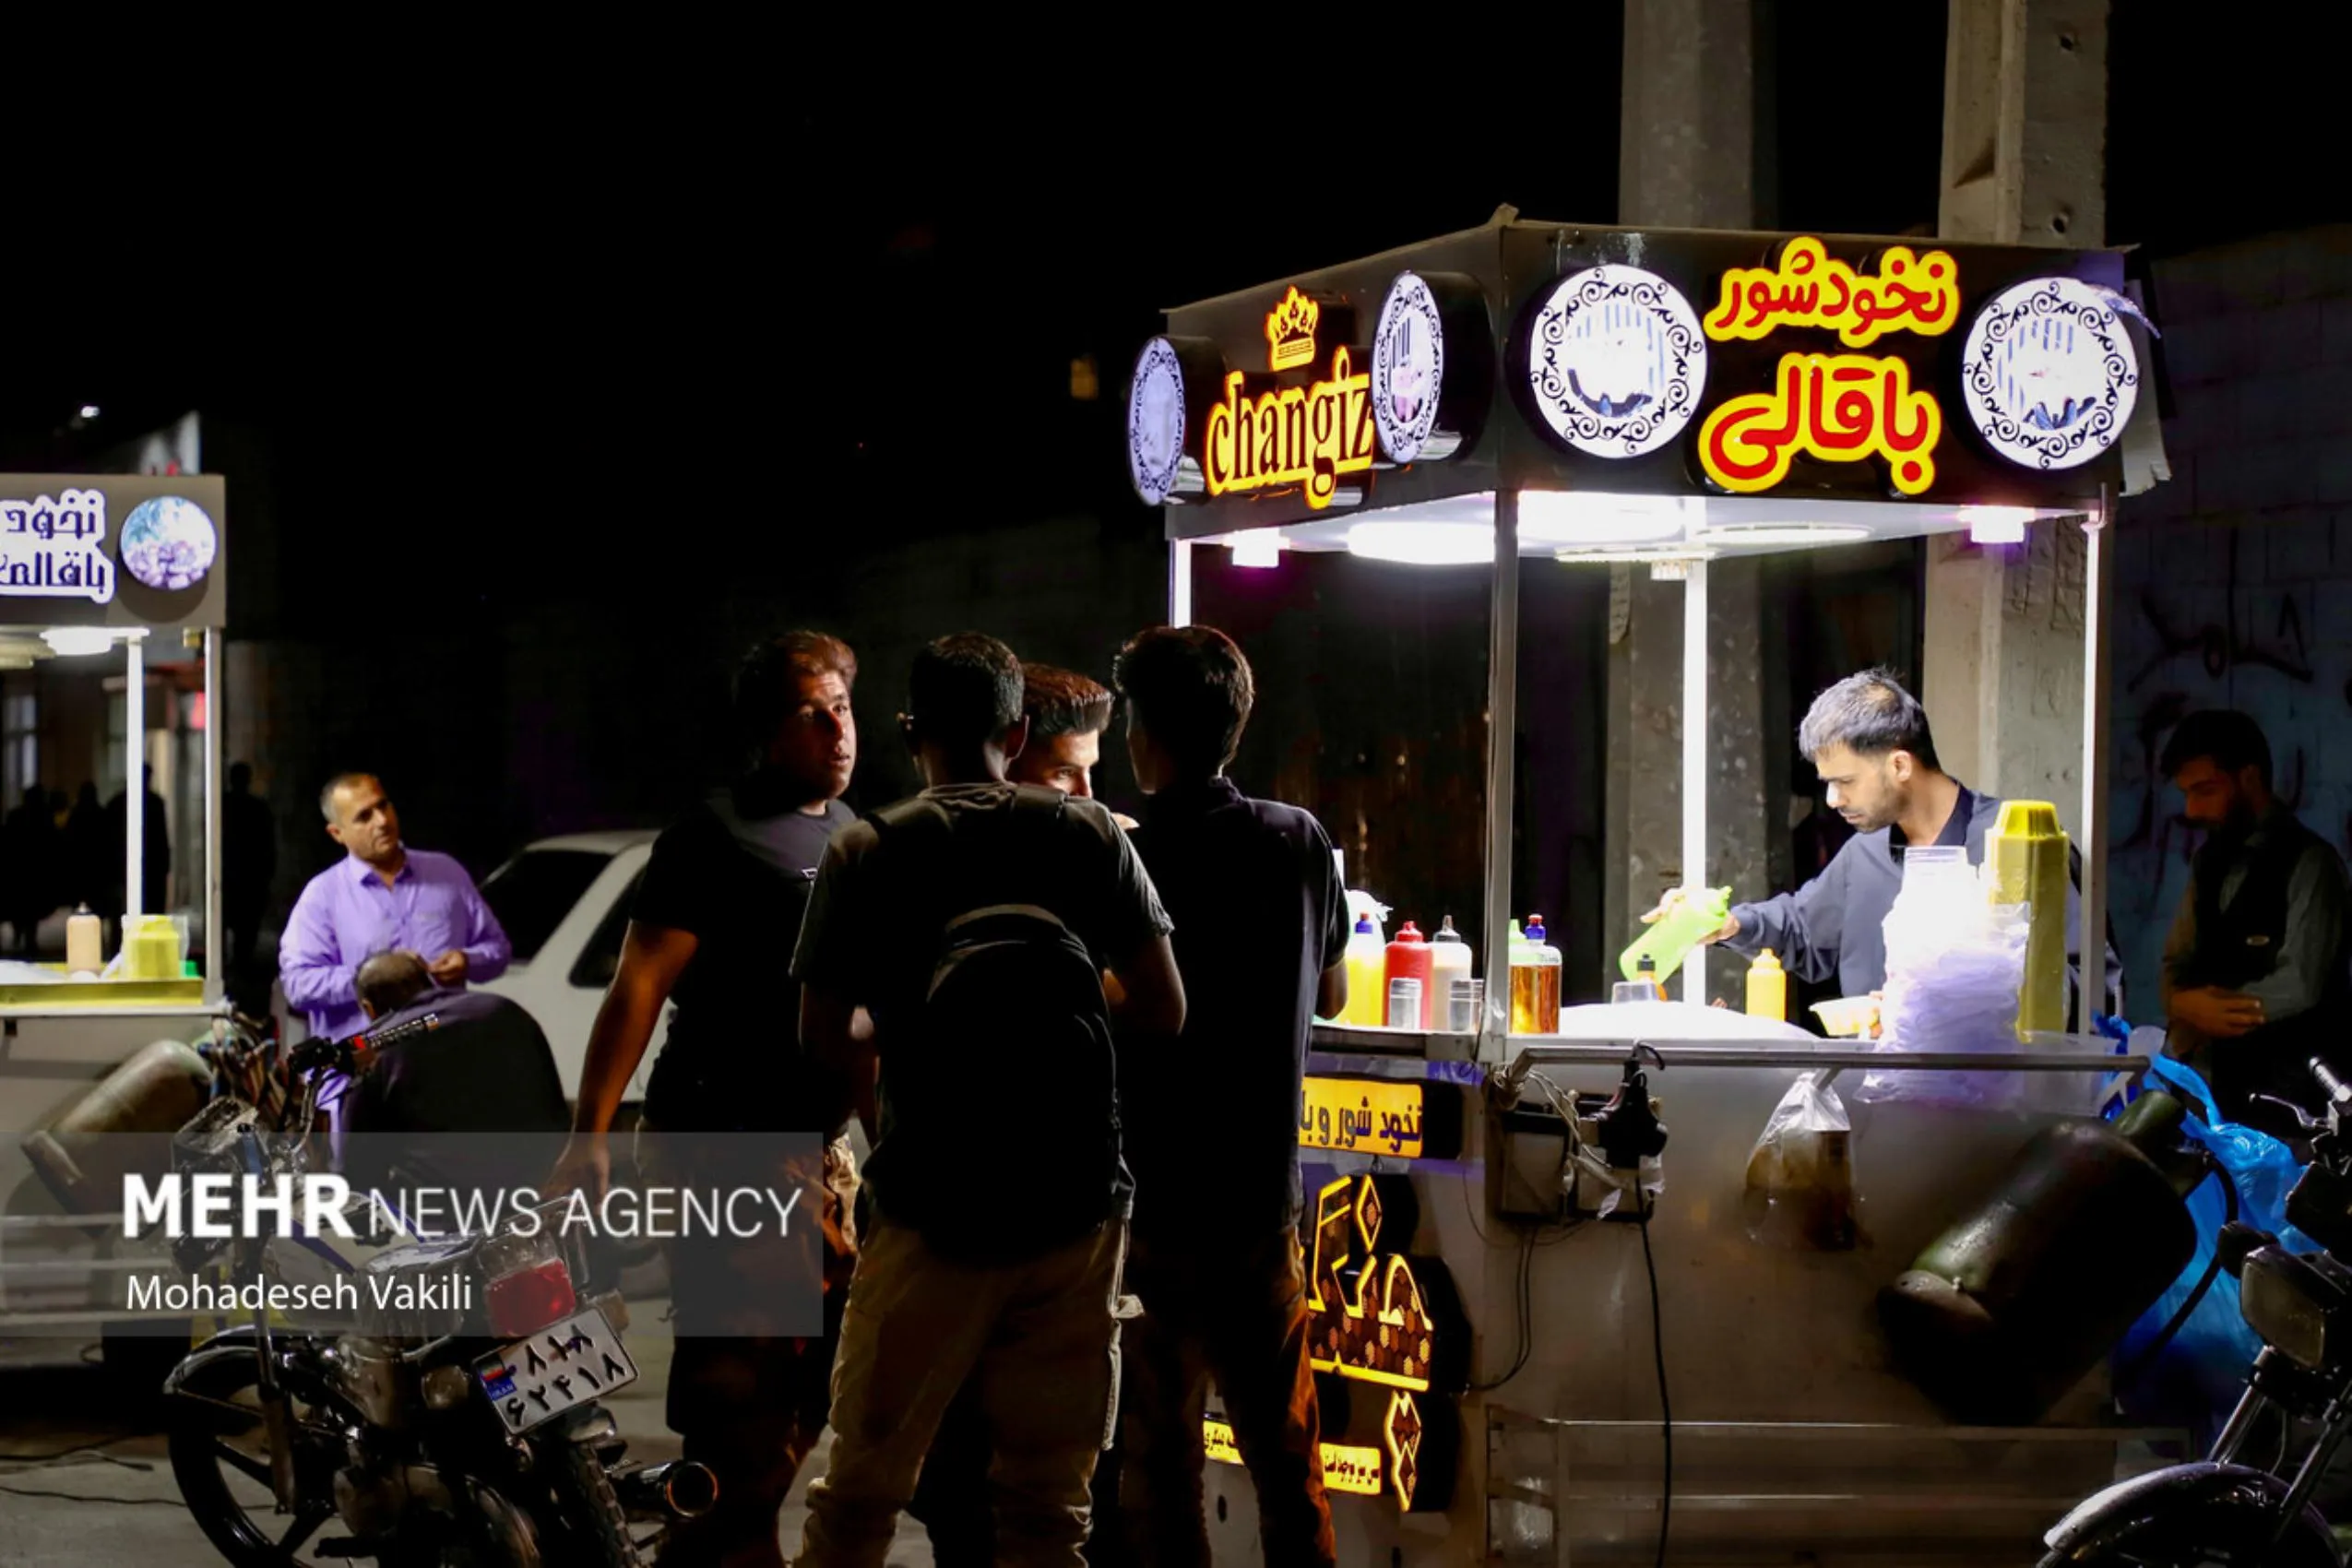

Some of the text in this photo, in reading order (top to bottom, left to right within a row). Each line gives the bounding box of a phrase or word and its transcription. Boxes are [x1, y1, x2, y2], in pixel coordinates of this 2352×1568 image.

[1207, 346, 1374, 498] changiz
[1709, 362, 1930, 483] باقالی
[5, 497, 96, 540] نخود
[1318, 1107, 1330, 1146] و
[1335, 1096, 1372, 1147] شور
[1379, 1104, 1422, 1153] نخود
